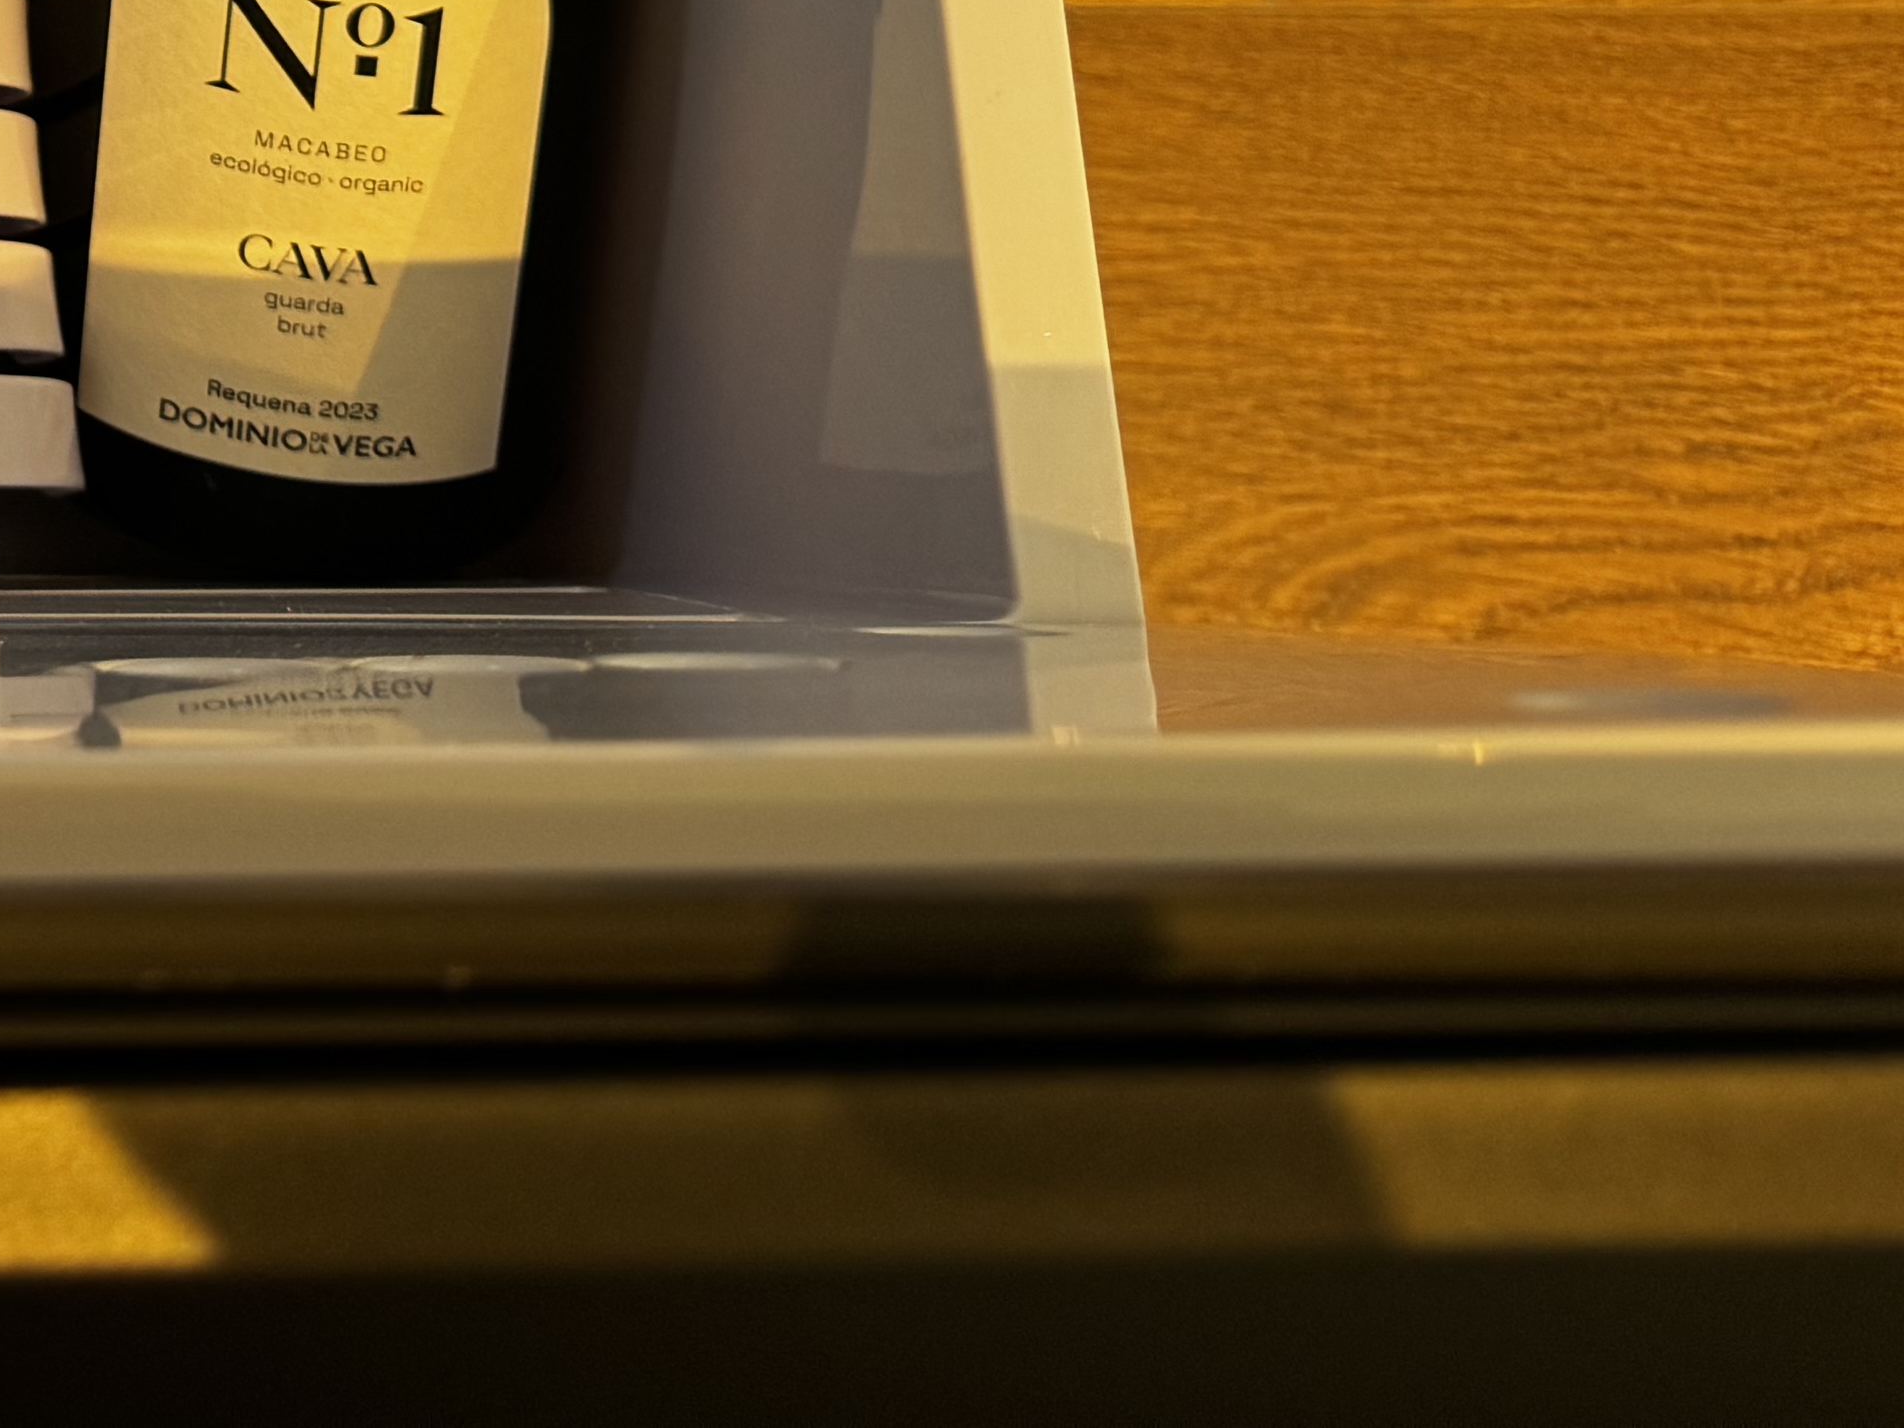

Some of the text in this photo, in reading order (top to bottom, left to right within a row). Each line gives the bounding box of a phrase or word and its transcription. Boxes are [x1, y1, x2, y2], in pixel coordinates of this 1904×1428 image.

[254, 129, 387, 164] MACABEO
[209, 149, 424, 195] ecológico organic
[237, 233, 380, 287] CAVA
[264, 290, 345, 316] guarda
[277, 316, 328, 339] brut
[206, 378, 380, 421] Requena 2023
[158, 397, 307, 452] DOMINIO
[331, 435, 418, 458] VEGA
